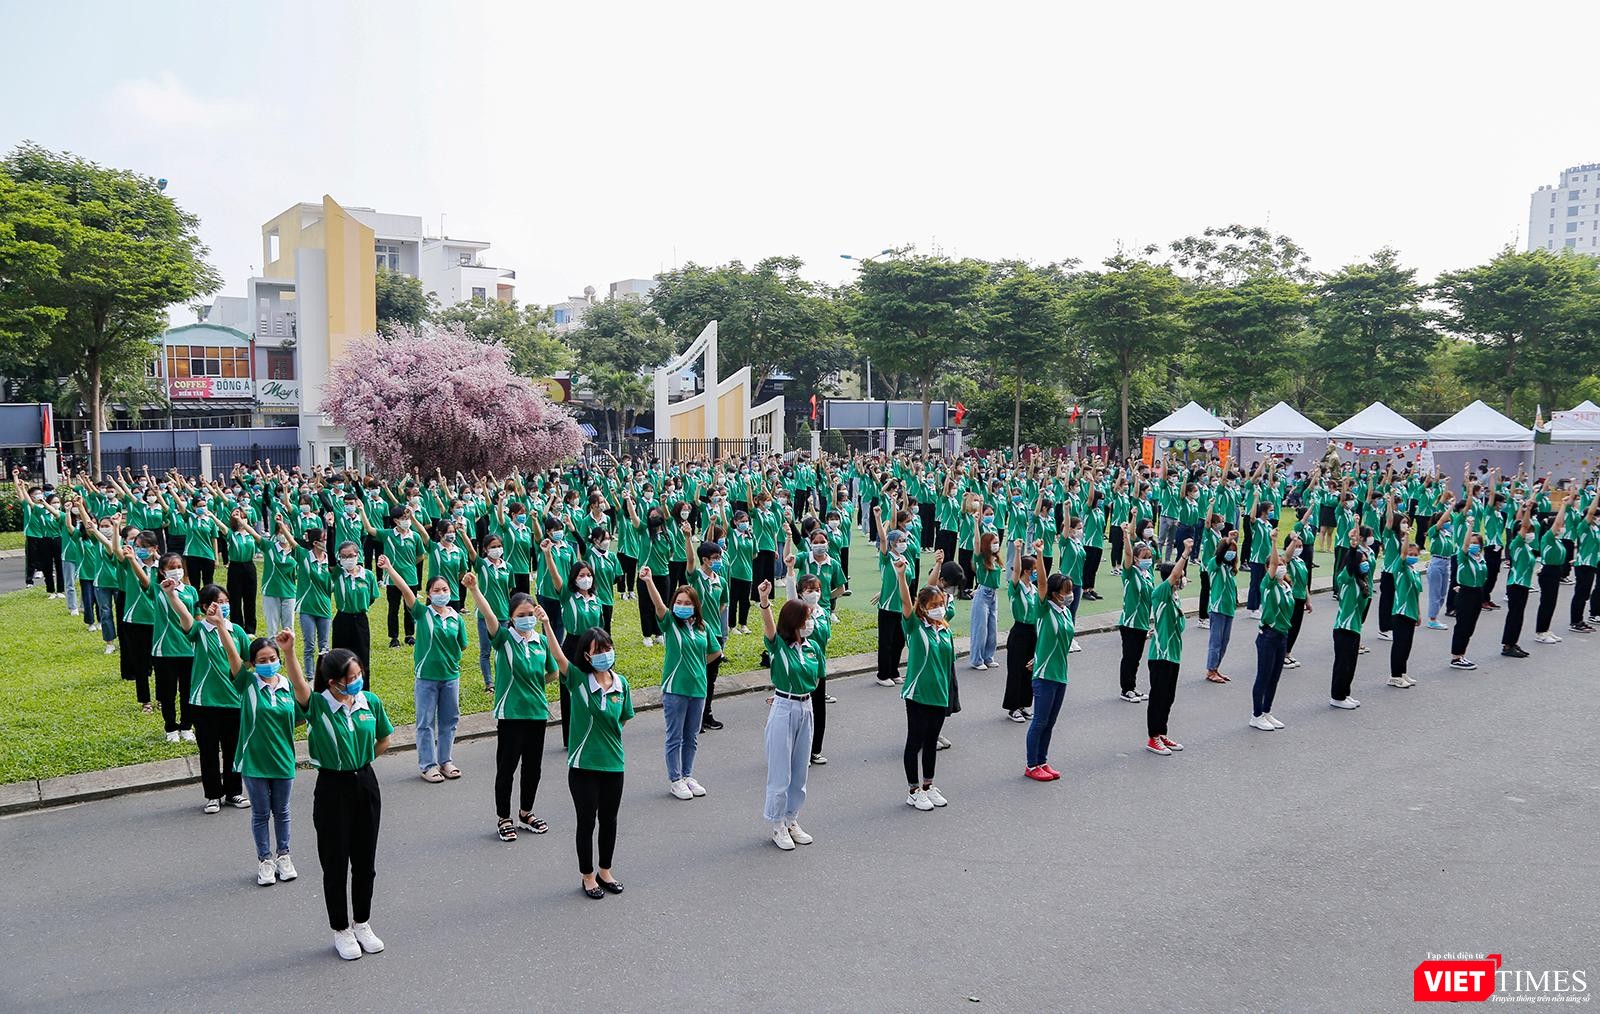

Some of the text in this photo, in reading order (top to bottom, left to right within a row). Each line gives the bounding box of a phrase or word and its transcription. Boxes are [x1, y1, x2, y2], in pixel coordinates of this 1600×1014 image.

[174, 380, 208, 389] COFFEE
[216, 379, 241, 390] ĐÔNG
[261, 381, 294, 400] May
